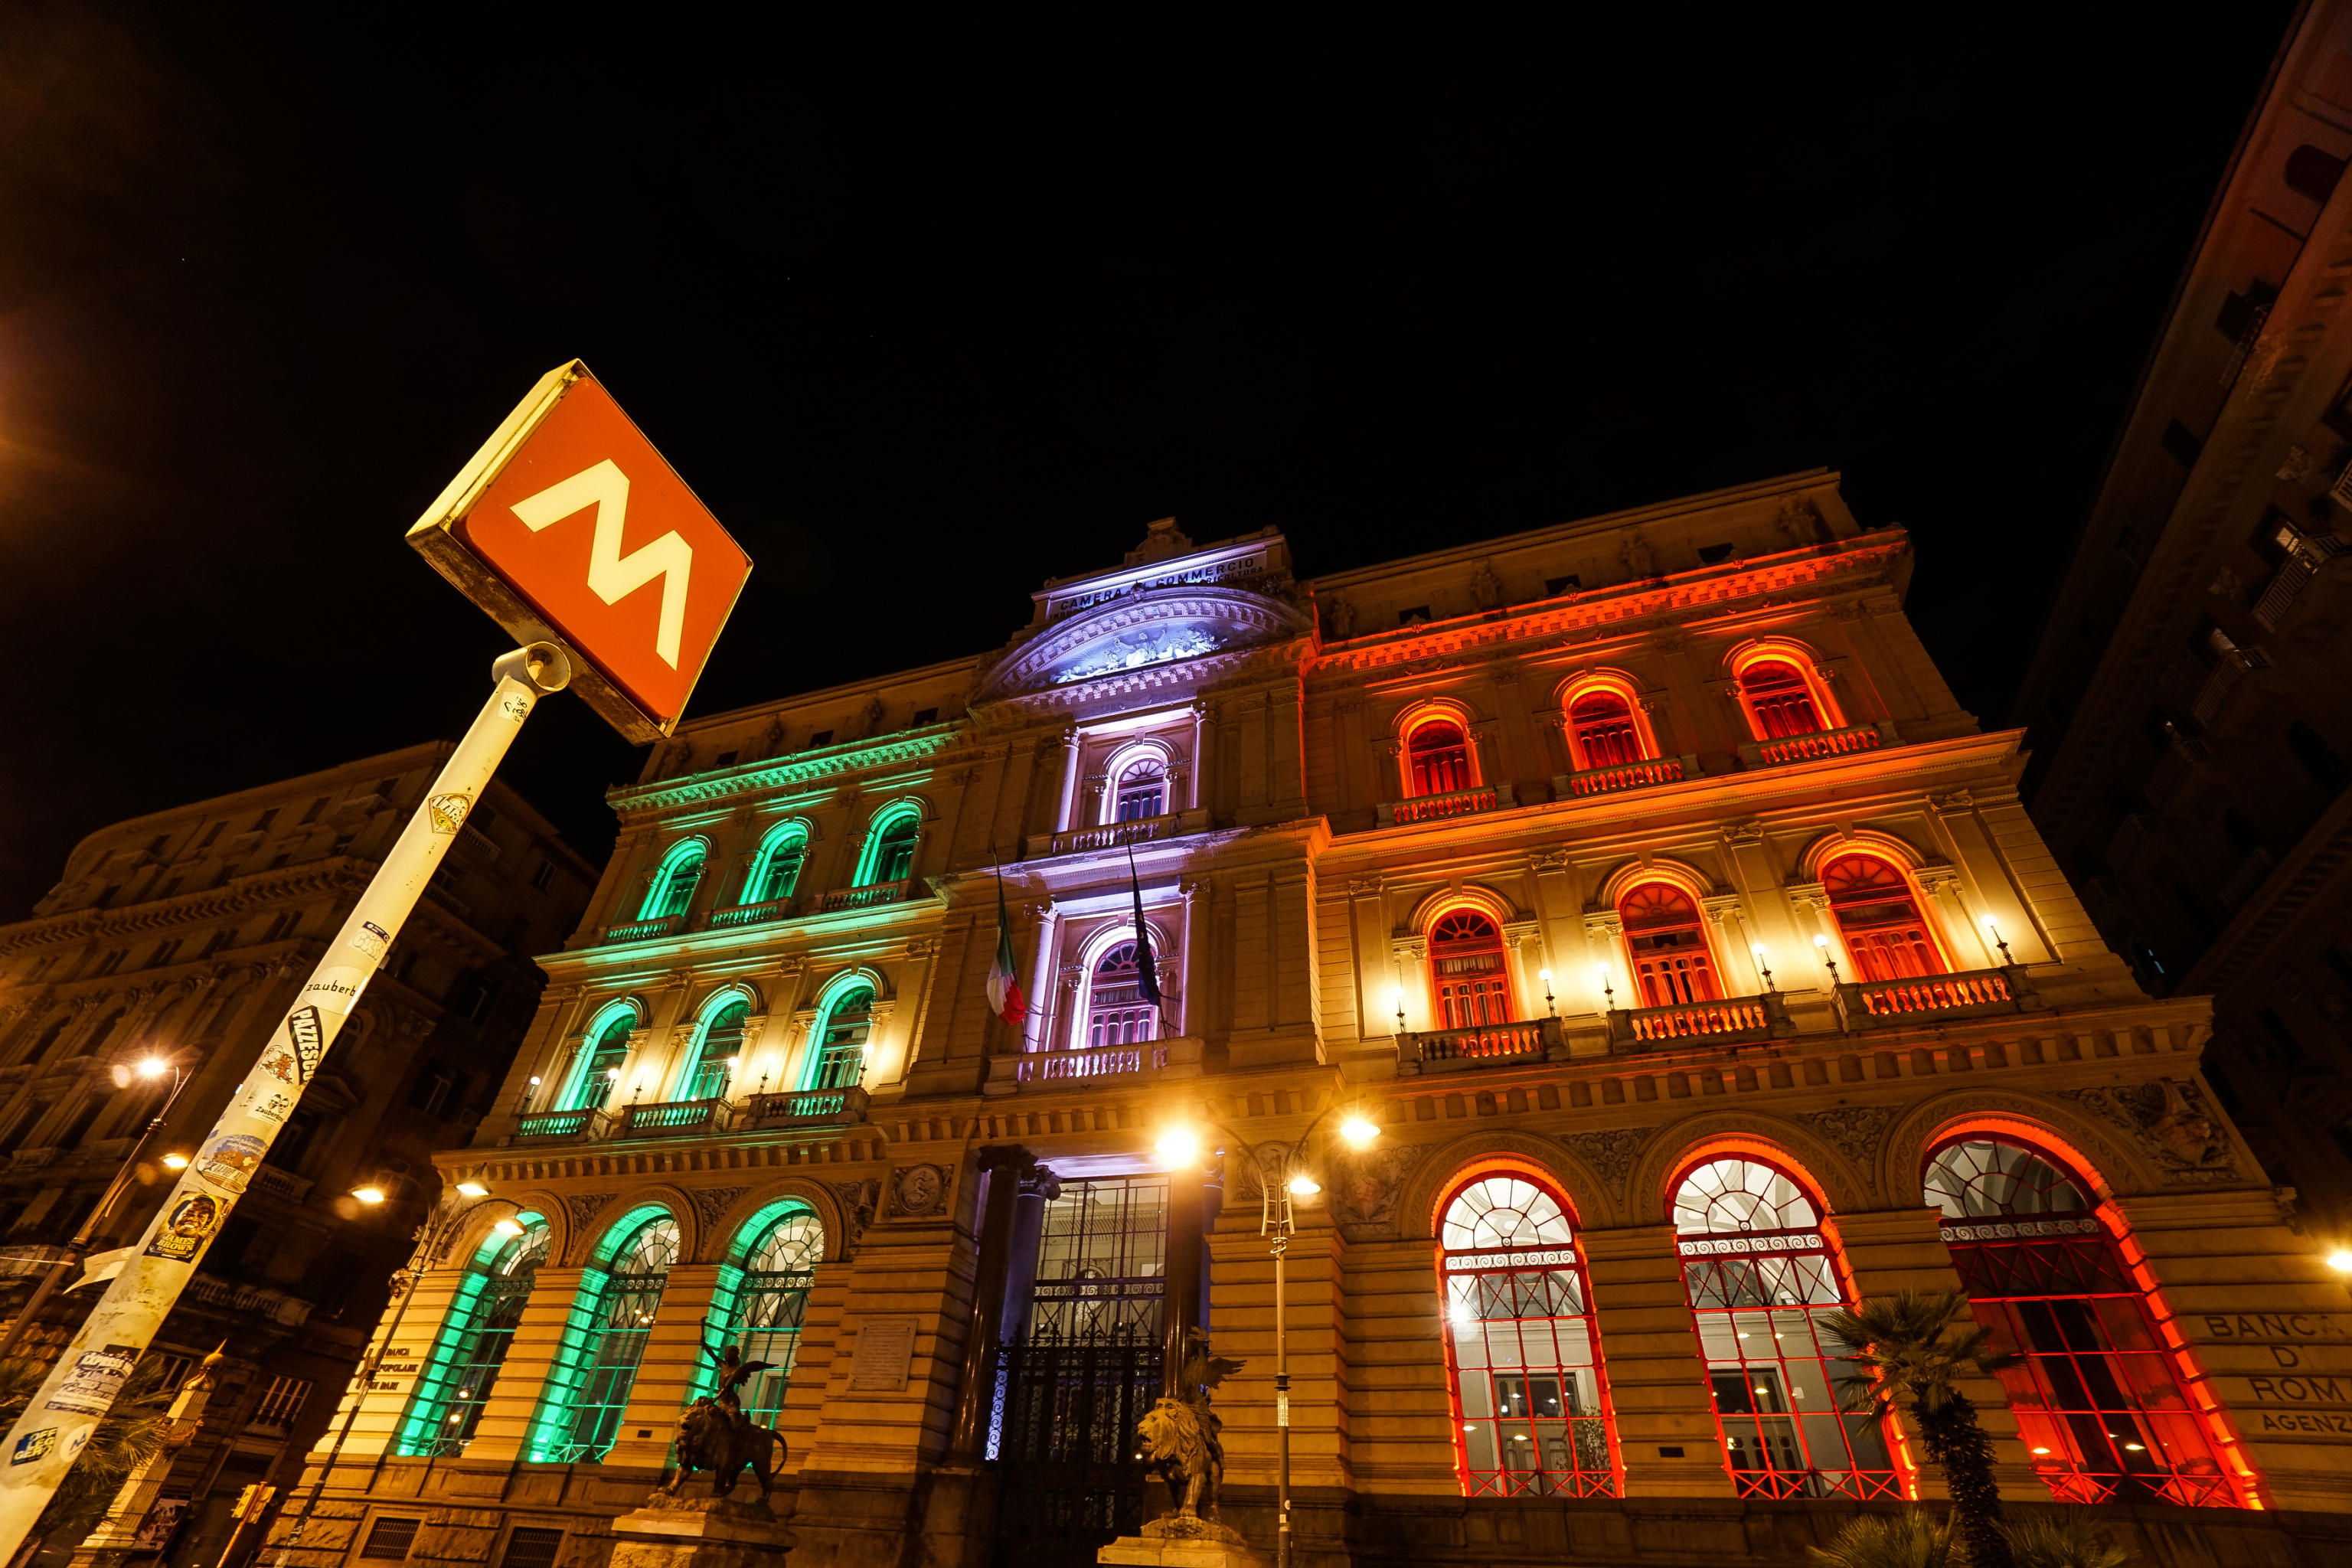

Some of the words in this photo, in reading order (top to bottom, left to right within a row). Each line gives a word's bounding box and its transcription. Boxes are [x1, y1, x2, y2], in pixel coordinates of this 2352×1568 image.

[508, 458, 694, 672] M
[1206, 566, 1263, 584] RICOLTURA
[1060, 587, 1122, 610] CAMERA
[1155, 557, 1254, 586] COMMERCIO
[156, 1240, 194, 1251] BROWN
[162, 1233, 197, 1245] JAMES
[2248, 1377, 2352, 1402] ROM
